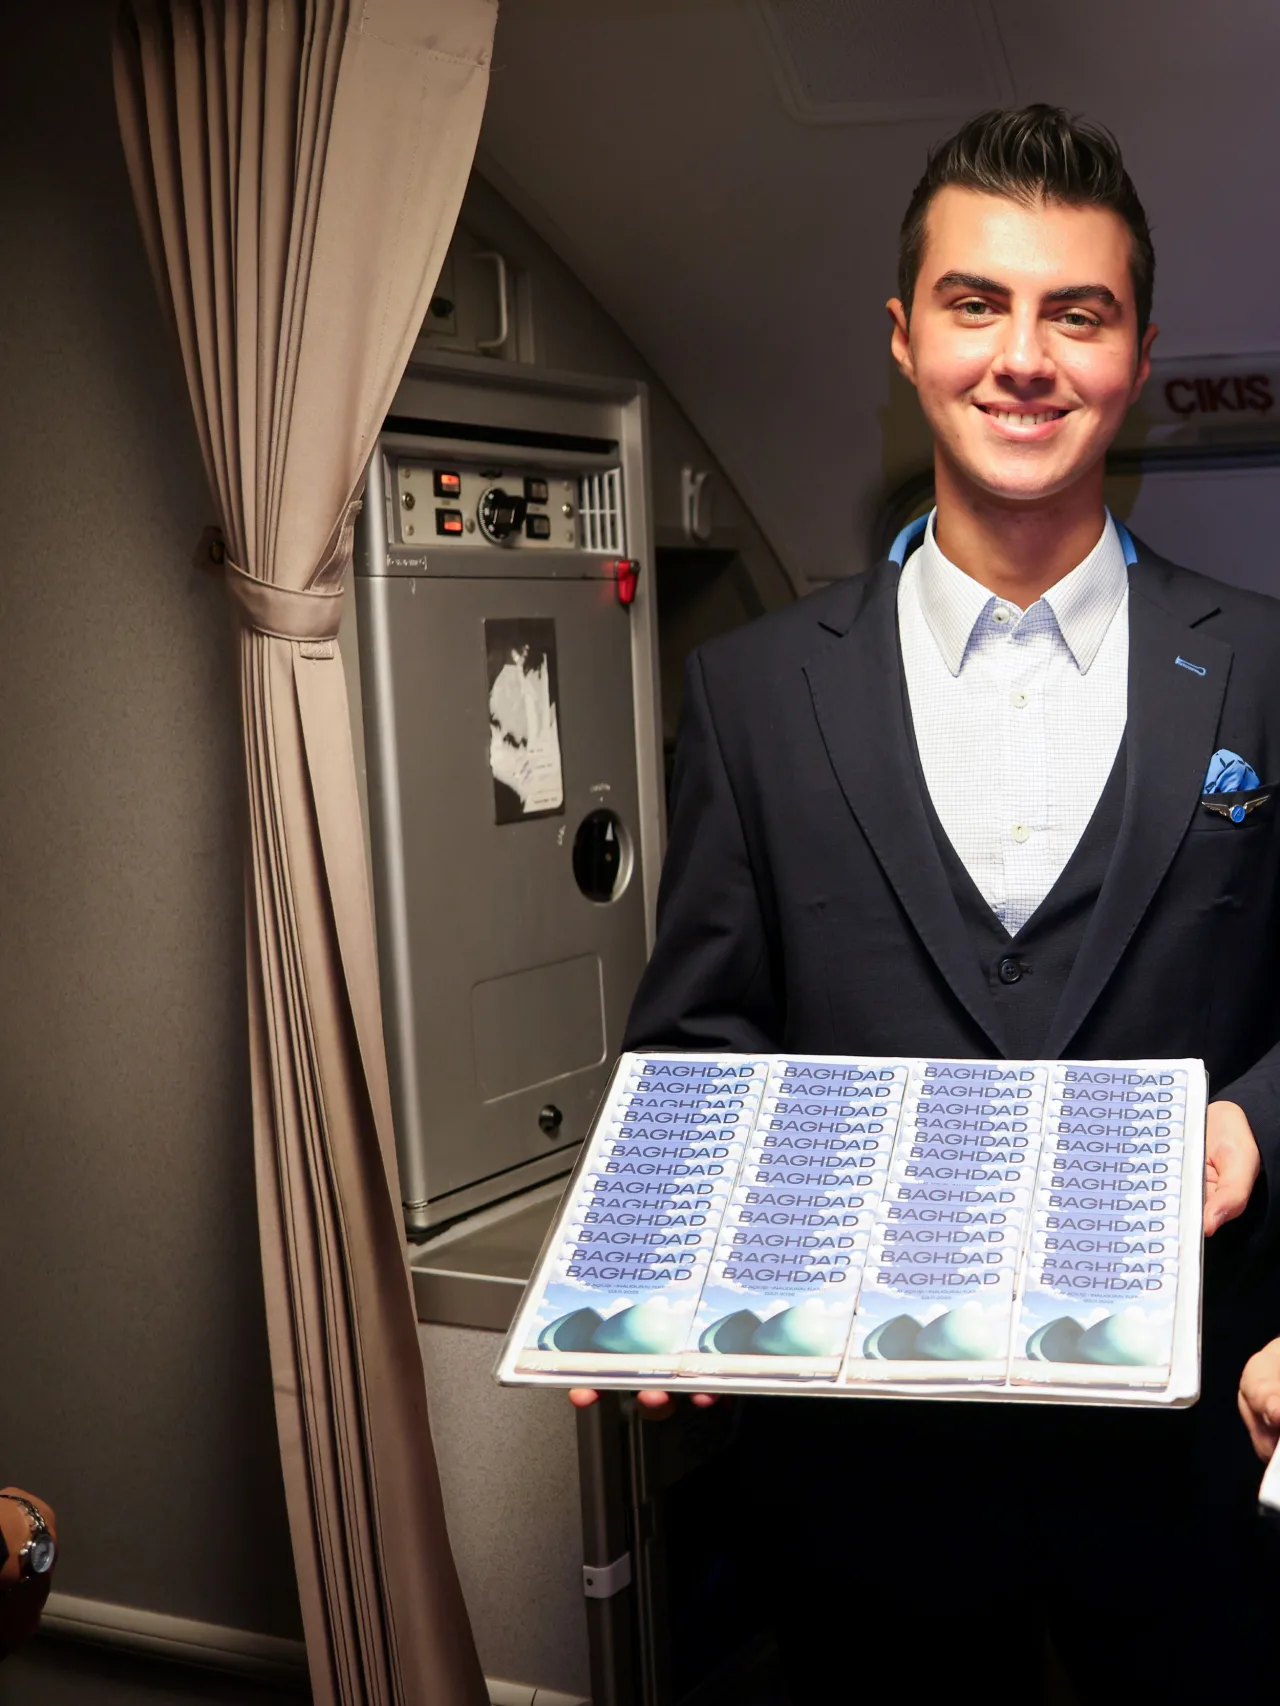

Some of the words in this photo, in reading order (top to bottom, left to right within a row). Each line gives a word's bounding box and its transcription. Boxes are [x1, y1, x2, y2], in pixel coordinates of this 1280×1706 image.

[642, 1065, 754, 1078] BAGHDAD
[784, 1066, 895, 1081] BAGHDAD
[925, 1066, 1035, 1081] BAGHDAD
[1065, 1071, 1174, 1086] BAGHDAD
[637, 1081, 750, 1094] BAGHDAD
[779, 1083, 891, 1098] BAGHDAD
[921, 1084, 1032, 1099] BAGHDAD
[1062, 1088, 1173, 1103] BAGHDAD
[774, 1103, 887, 1117] BAGHDAD
[917, 1103, 1029, 1116] BAGHDAD
[1060, 1105, 1172, 1120] BAGHDAD
[624, 1111, 740, 1124] BAGHDAD
[914, 1117, 1027, 1133] BAGHDAD
[619, 1128, 735, 1141] BAGHDAD
[769, 1120, 883, 1134] BAGHDAD
[1058, 1122, 1170, 1137] BAGHDAD
[764, 1136, 879, 1151] BAGHDAD
[914, 1132, 1028, 1148] BAGHDAD
[1056, 1139, 1170, 1154] BAGHDAD
[611, 1145, 729, 1158] BAGHDAD
[910, 1147, 1025, 1163] BAGHDAD
[759, 1153, 875, 1168] BAGHDAD
[1053, 1158, 1168, 1174] BAGHDAD
[605, 1162, 724, 1176] BAGHDAD
[905, 1165, 1020, 1181] BAGHDAD
[755, 1171, 873, 1186] BAGHDAD
[1051, 1177, 1167, 1191] BAGHDAD
[594, 1180, 714, 1195] BAGHDAD
[745, 1192, 864, 1208] BAGHDAD
[898, 1188, 1015, 1203] BAGHDAD
[1049, 1195, 1166, 1211] BAGHDAD
[584, 1211, 706, 1226] BAGHDAD
[739, 1211, 859, 1227] BAGHDAD
[887, 1207, 1006, 1224] BAGHDAD
[1046, 1217, 1165, 1232] BAGHDAD
[578, 1230, 702, 1245] BAGHDAD
[733, 1232, 855, 1248] BAGHDAD
[884, 1230, 1005, 1243] BAGHDAD
[1045, 1238, 1165, 1253] BAGHDAD
[572, 1249, 696, 1263] BAGHDAD
[881, 1250, 1003, 1264] BAGHDAD
[566, 1265, 692, 1281] BAGHDAD
[722, 1267, 846, 1283] BAGHDAD
[876, 1272, 1000, 1285] BAGHDAD
[1040, 1273, 1163, 1290] BAGHDAD
